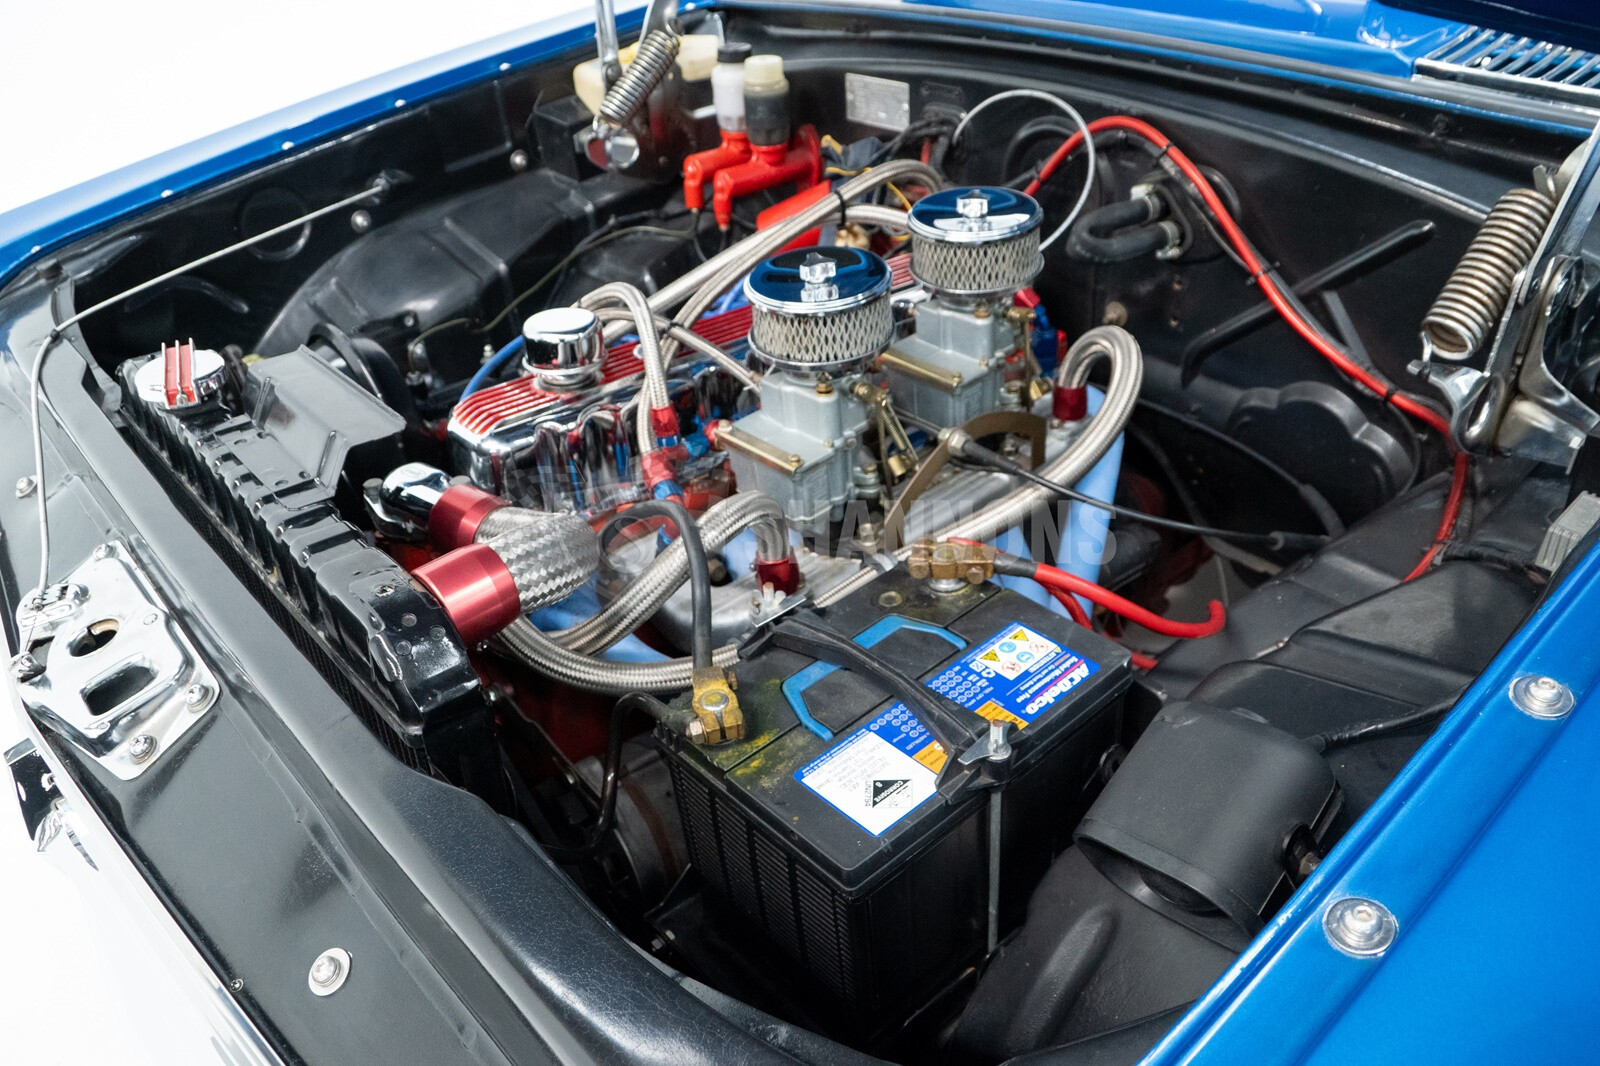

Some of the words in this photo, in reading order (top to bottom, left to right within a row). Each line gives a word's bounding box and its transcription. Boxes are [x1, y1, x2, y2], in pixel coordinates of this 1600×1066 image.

[1015, 691, 1030, 702] Free
[1025, 662, 1089, 714] ACDelco
[874, 780, 903, 802] CORROSIVE
